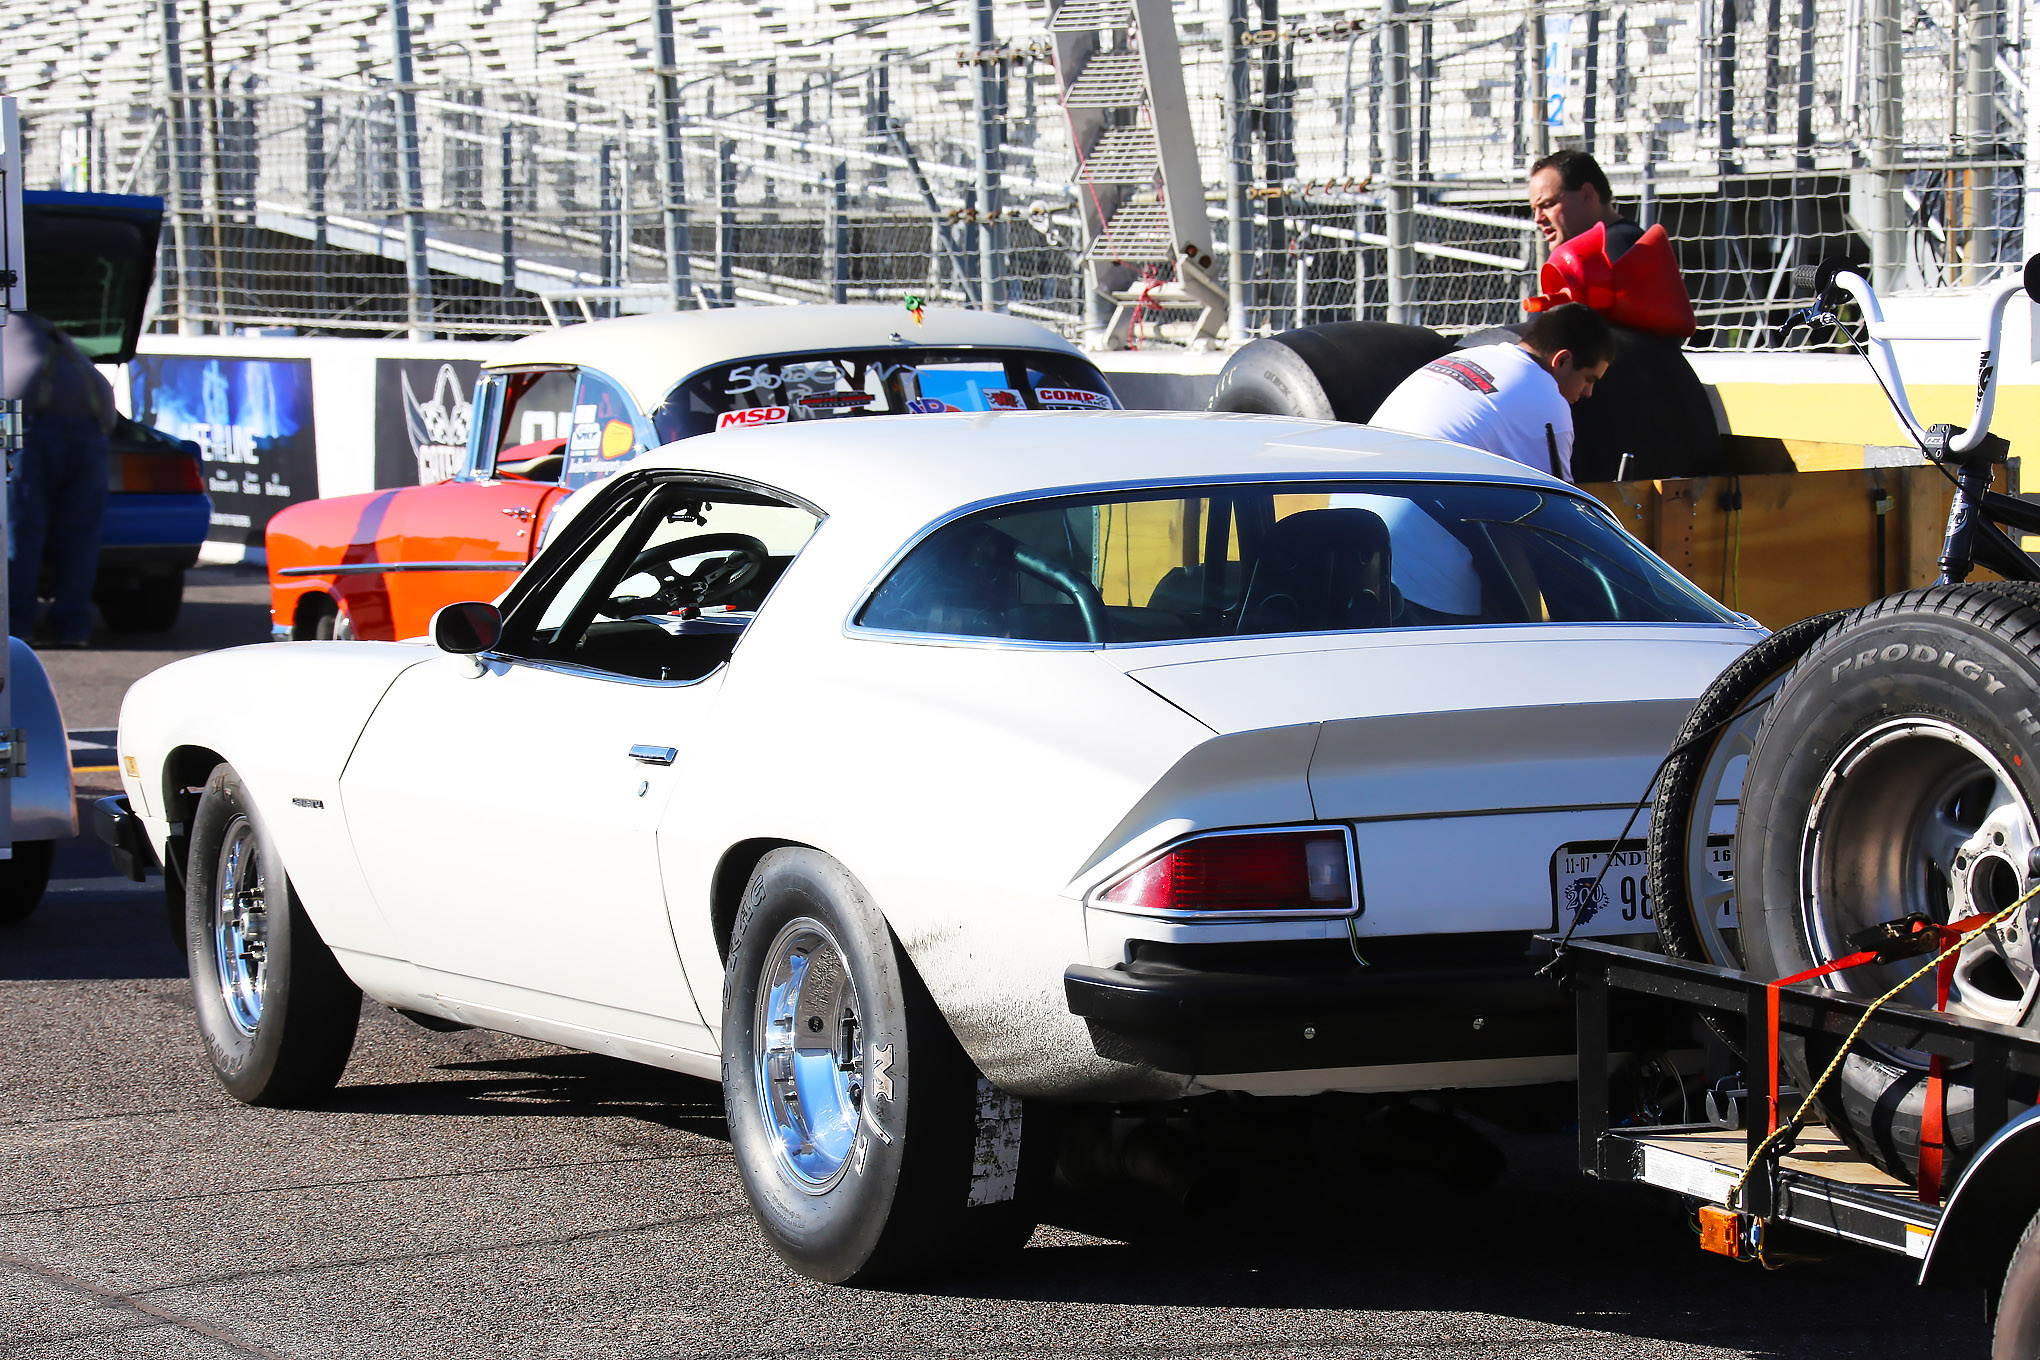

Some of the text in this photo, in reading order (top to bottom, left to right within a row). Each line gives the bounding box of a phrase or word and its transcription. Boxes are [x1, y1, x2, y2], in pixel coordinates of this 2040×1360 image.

[1040, 390, 1095, 402] COMP
[720, 407, 786, 428] MSD
[1830, 643, 2007, 696] PRODIGY
[1565, 856, 1590, 874] 11-07
[1712, 849, 1731, 863] 16
[1566, 883, 1604, 911] 200
